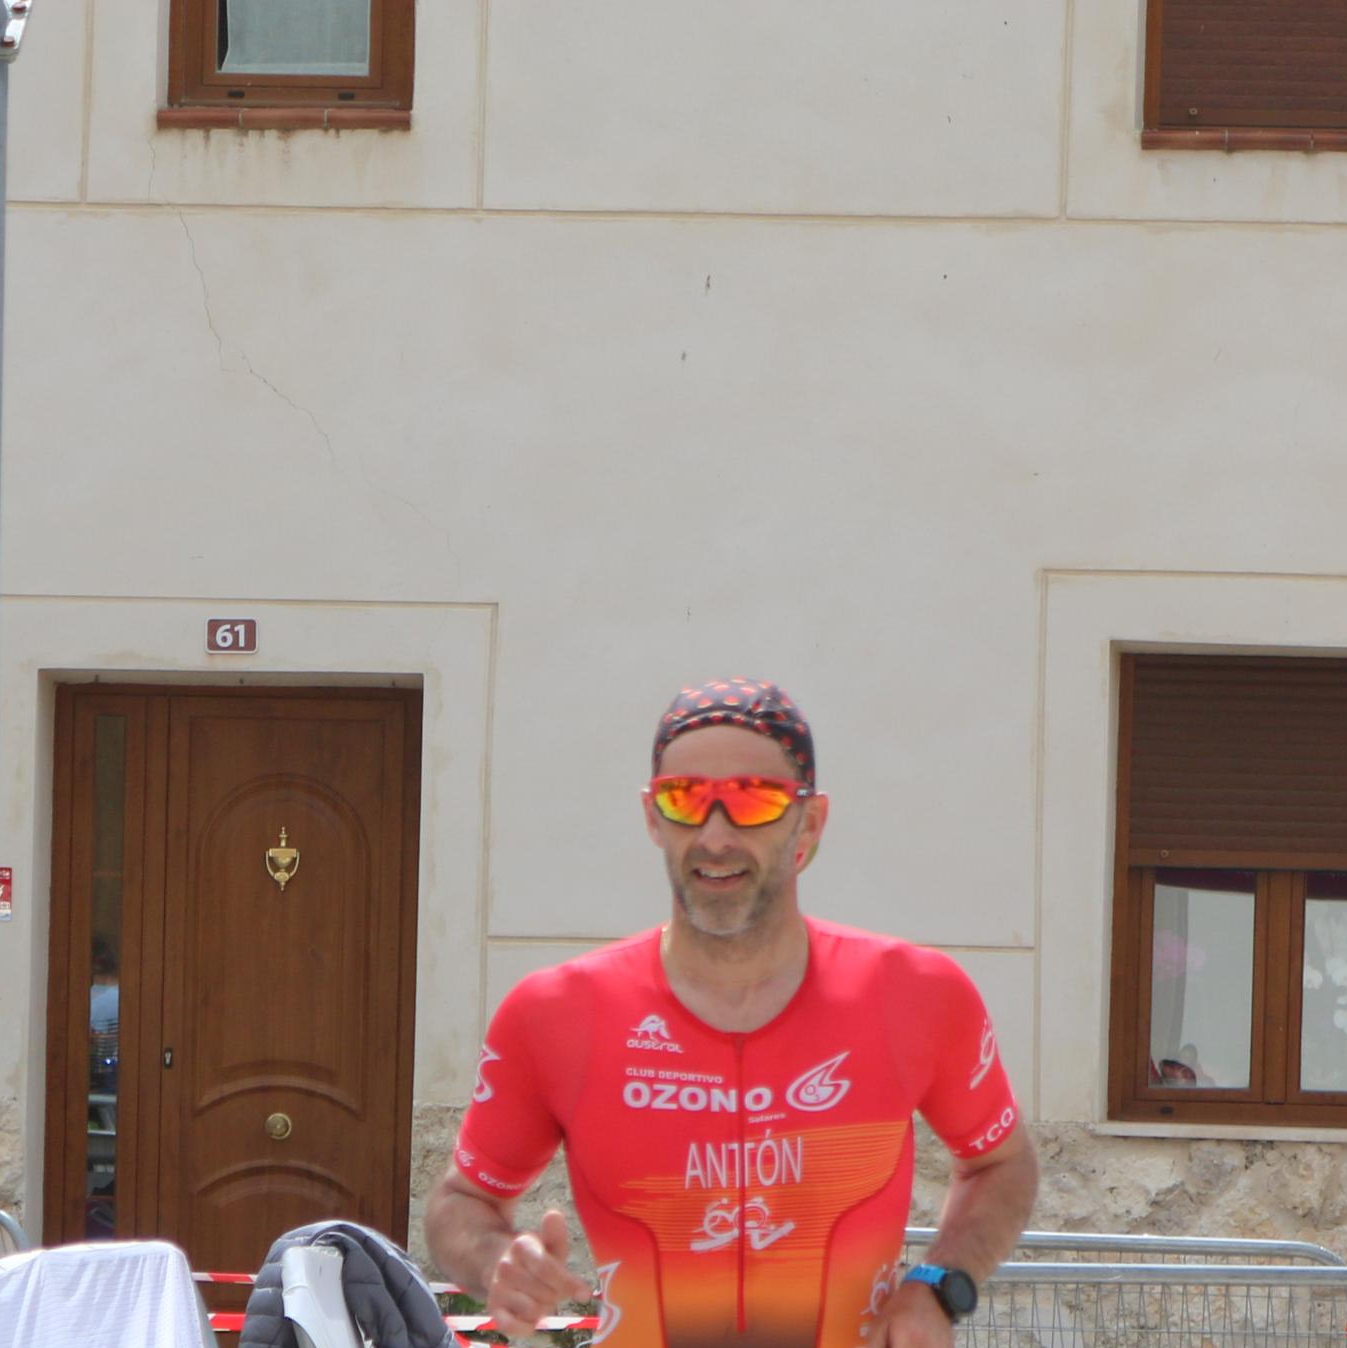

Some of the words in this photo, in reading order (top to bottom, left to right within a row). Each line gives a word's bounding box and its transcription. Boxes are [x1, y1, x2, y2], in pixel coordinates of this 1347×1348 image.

[216, 624, 246, 648] 61
[625, 1067, 655, 1078] CLUB
[658, 1071, 724, 1084] DEPORTIVO
[622, 1081, 773, 1113] OZONO
[684, 1128, 802, 1190] ANTÓN
